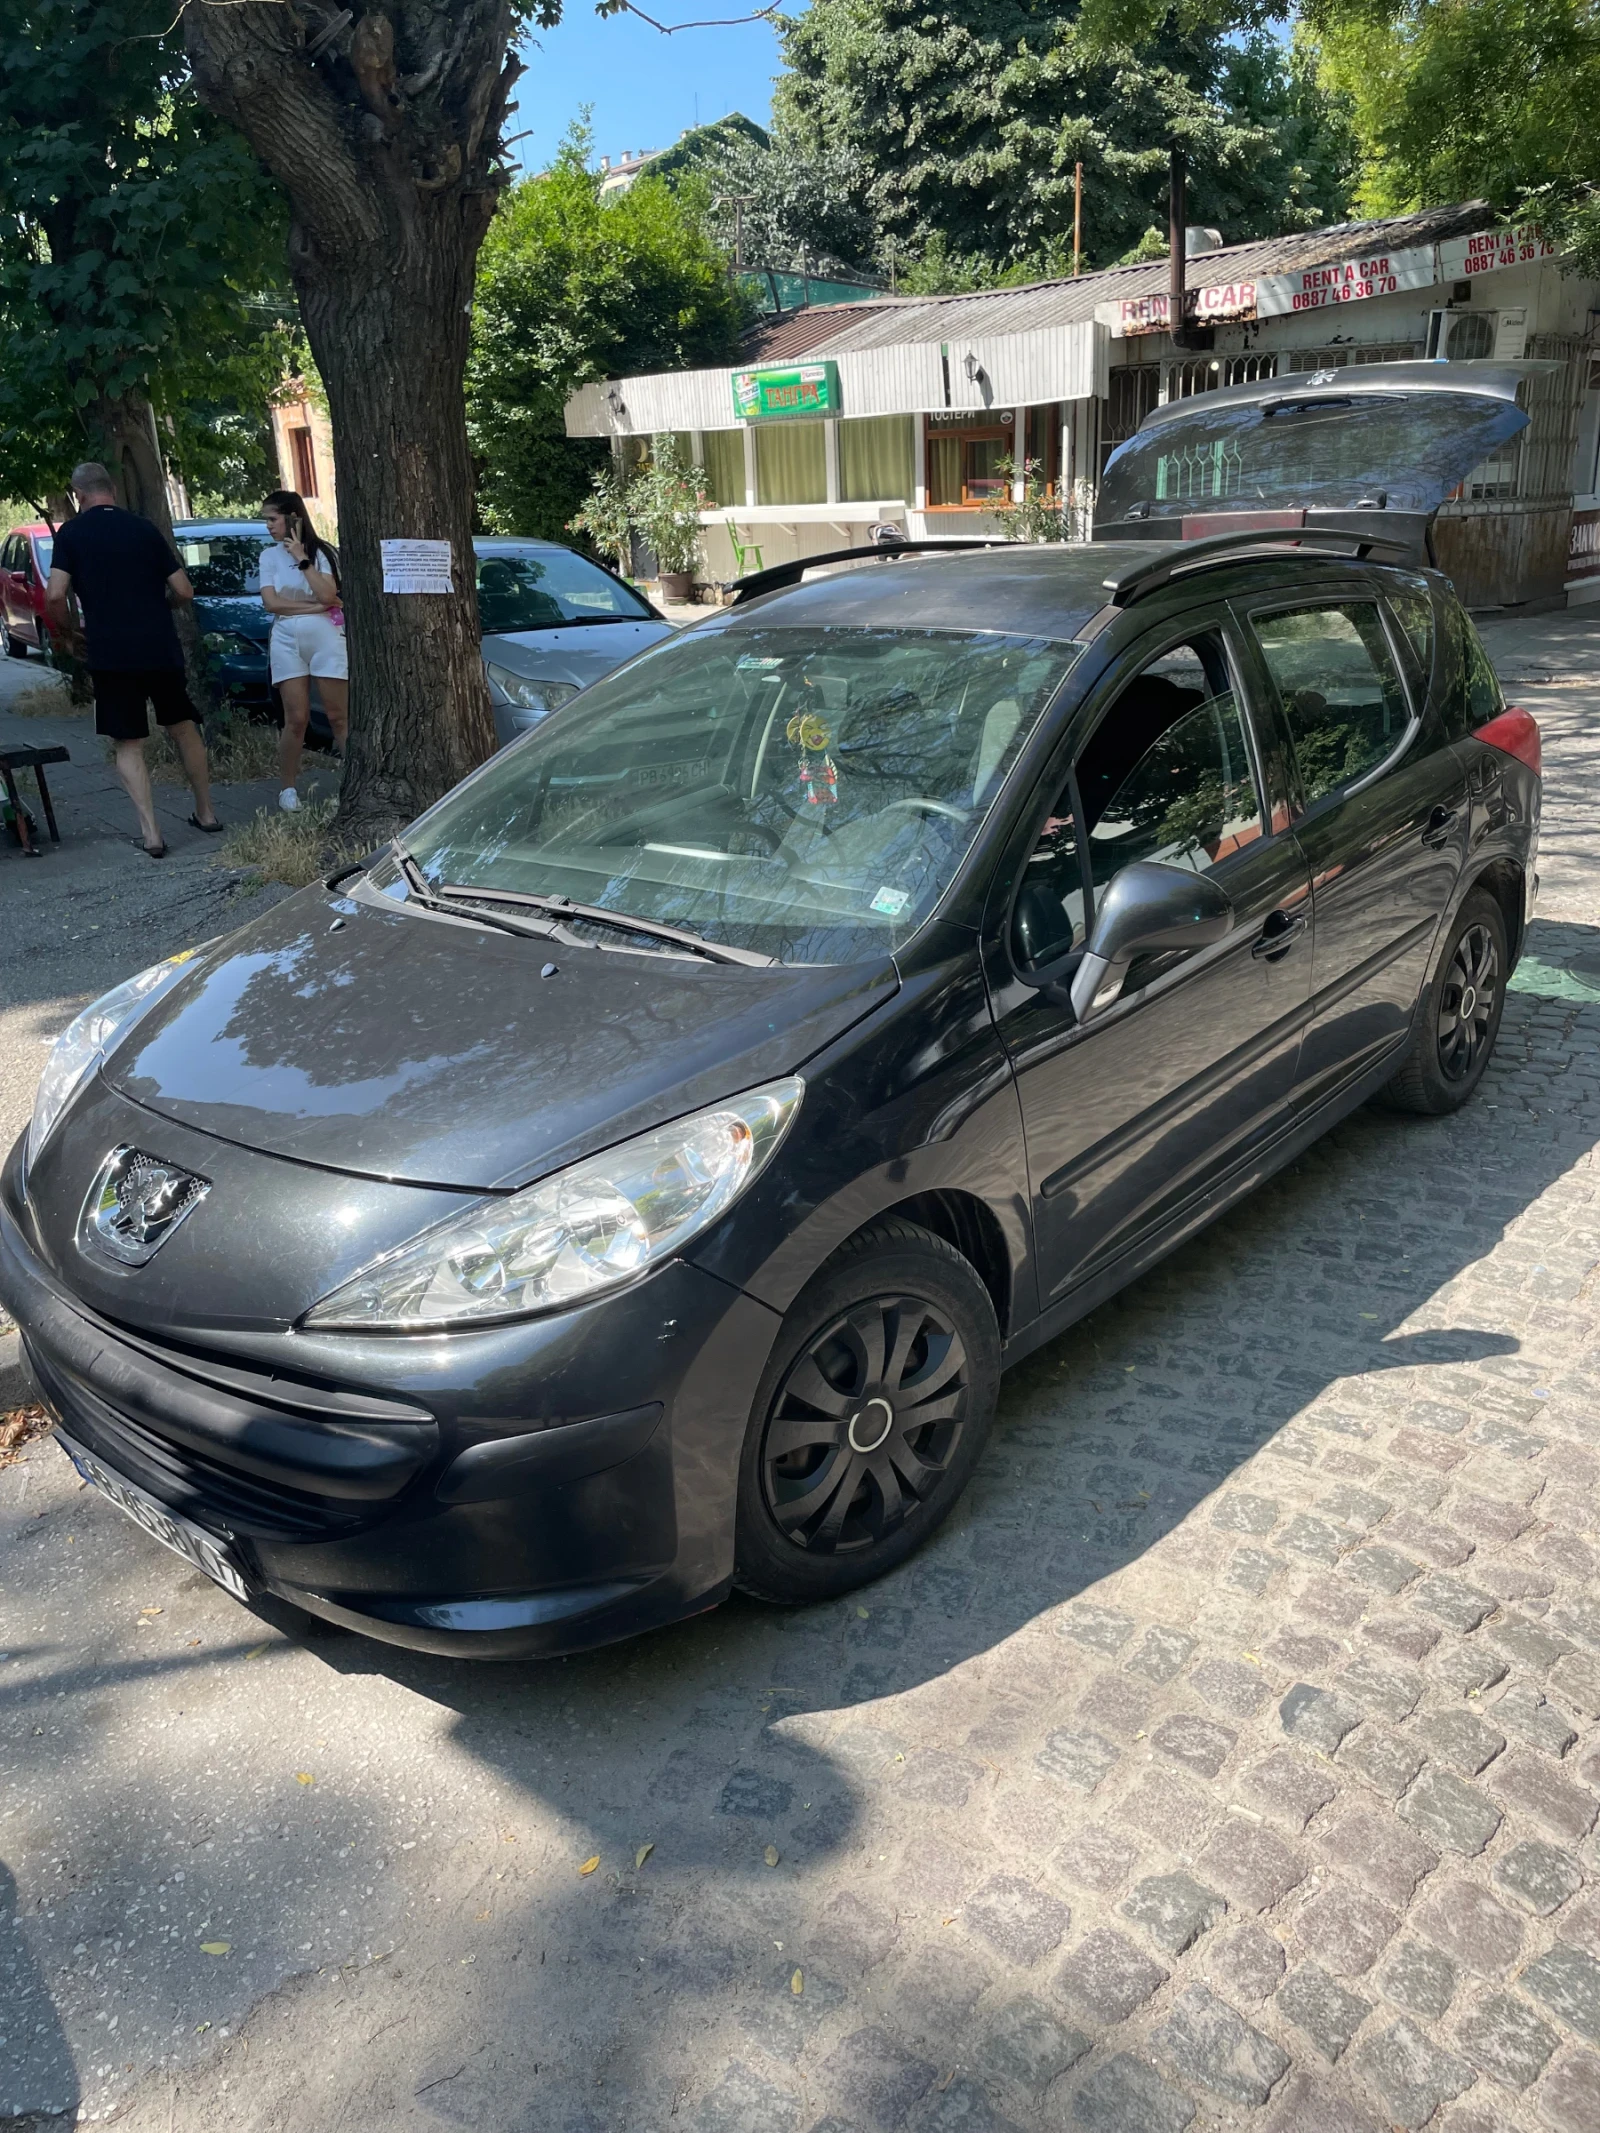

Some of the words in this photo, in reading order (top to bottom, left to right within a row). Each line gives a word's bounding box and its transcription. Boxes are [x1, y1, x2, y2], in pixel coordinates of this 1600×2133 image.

[1302, 267, 1340, 290] RENT
[1344, 265, 1355, 281] A
[1359, 258, 1390, 278] CAR
[1464, 253, 1496, 274] 0887
[1499, 247, 1515, 266] 46
[1519, 243, 1535, 261] 36
[1121, 295, 1169, 321] REN
[1204, 283, 1256, 311] CAR
[1292, 288, 1328, 310] 0887
[1332, 284, 1351, 302] 46
[1355, 280, 1374, 298] 36
[1378, 275, 1397, 294] 70
[765, 383, 820, 408] ТАНГРА
